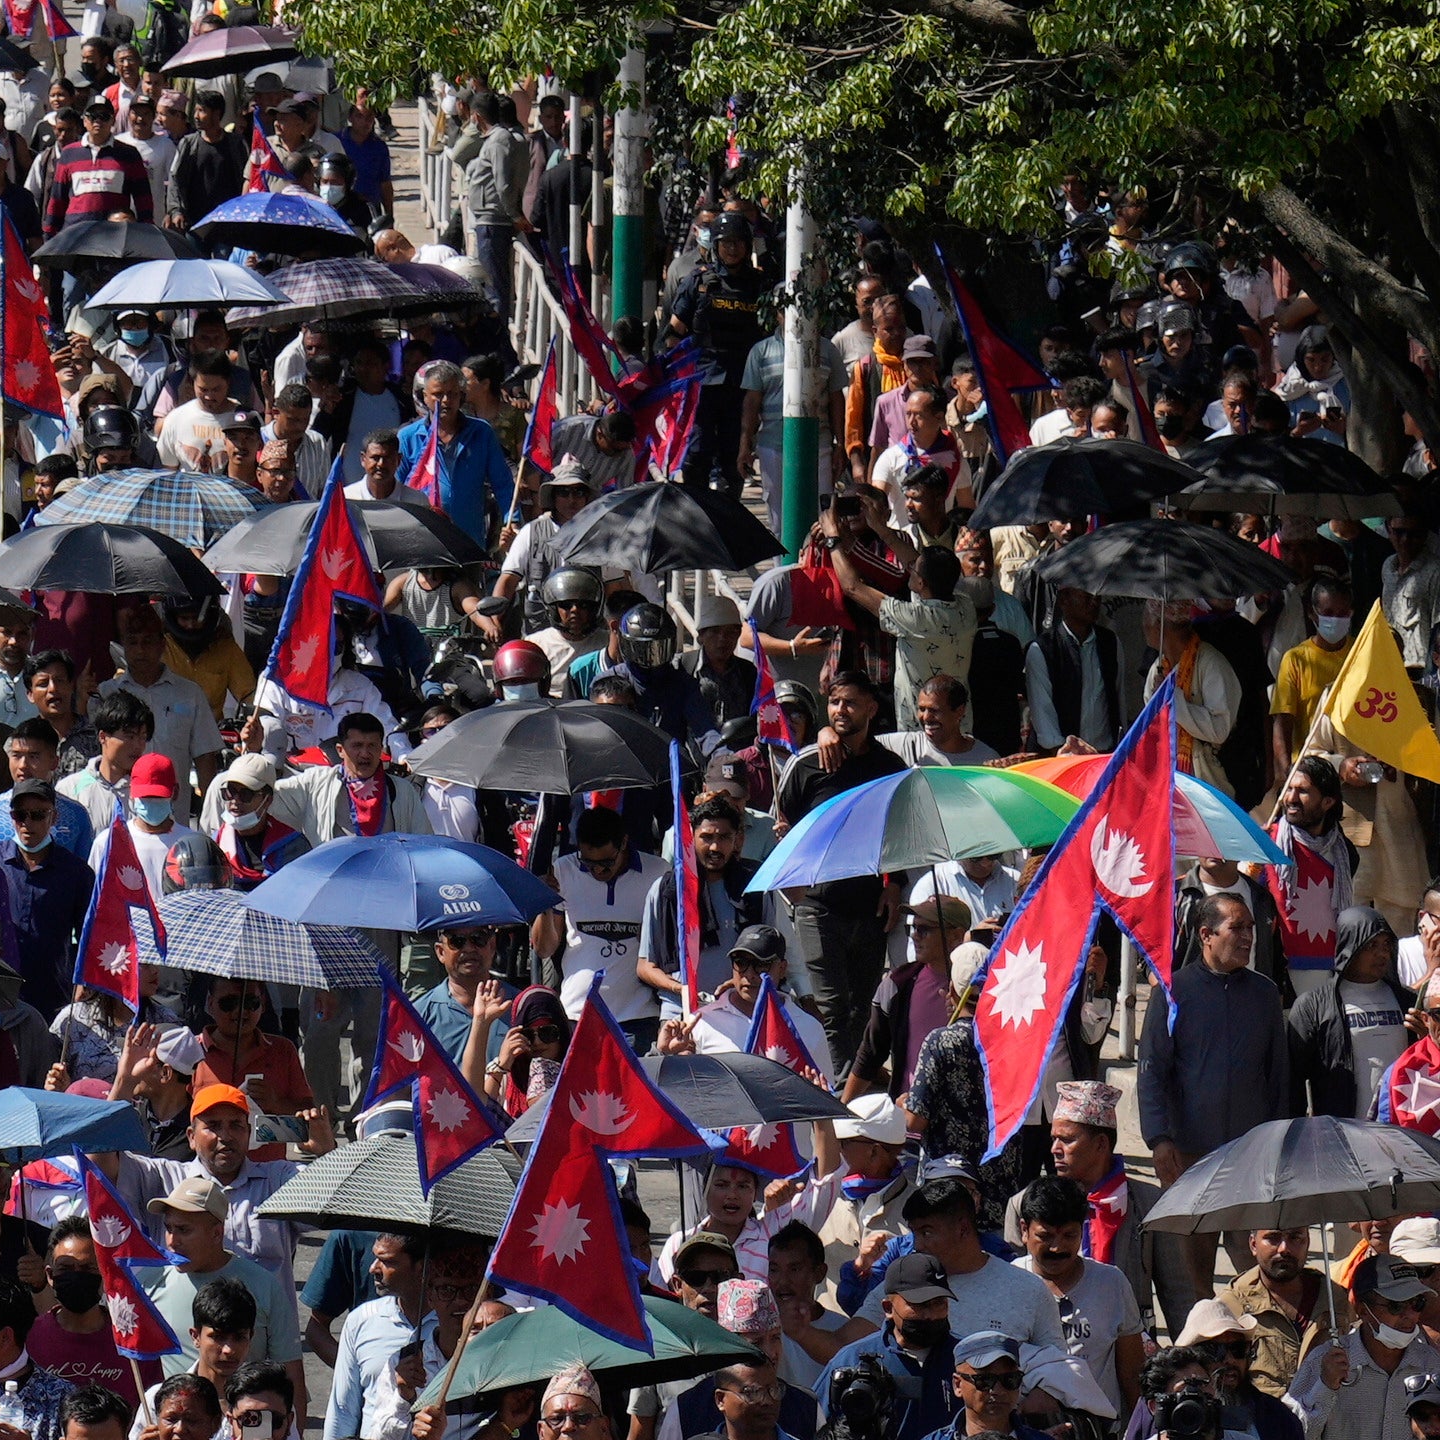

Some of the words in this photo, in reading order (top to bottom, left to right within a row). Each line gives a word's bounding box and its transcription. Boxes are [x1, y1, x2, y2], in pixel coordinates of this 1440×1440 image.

[711, 298, 734, 310] NEPAL
[734, 300, 759, 312] POLICE
[443, 900, 482, 915] AIBO
[90, 1362, 124, 1381] happy
